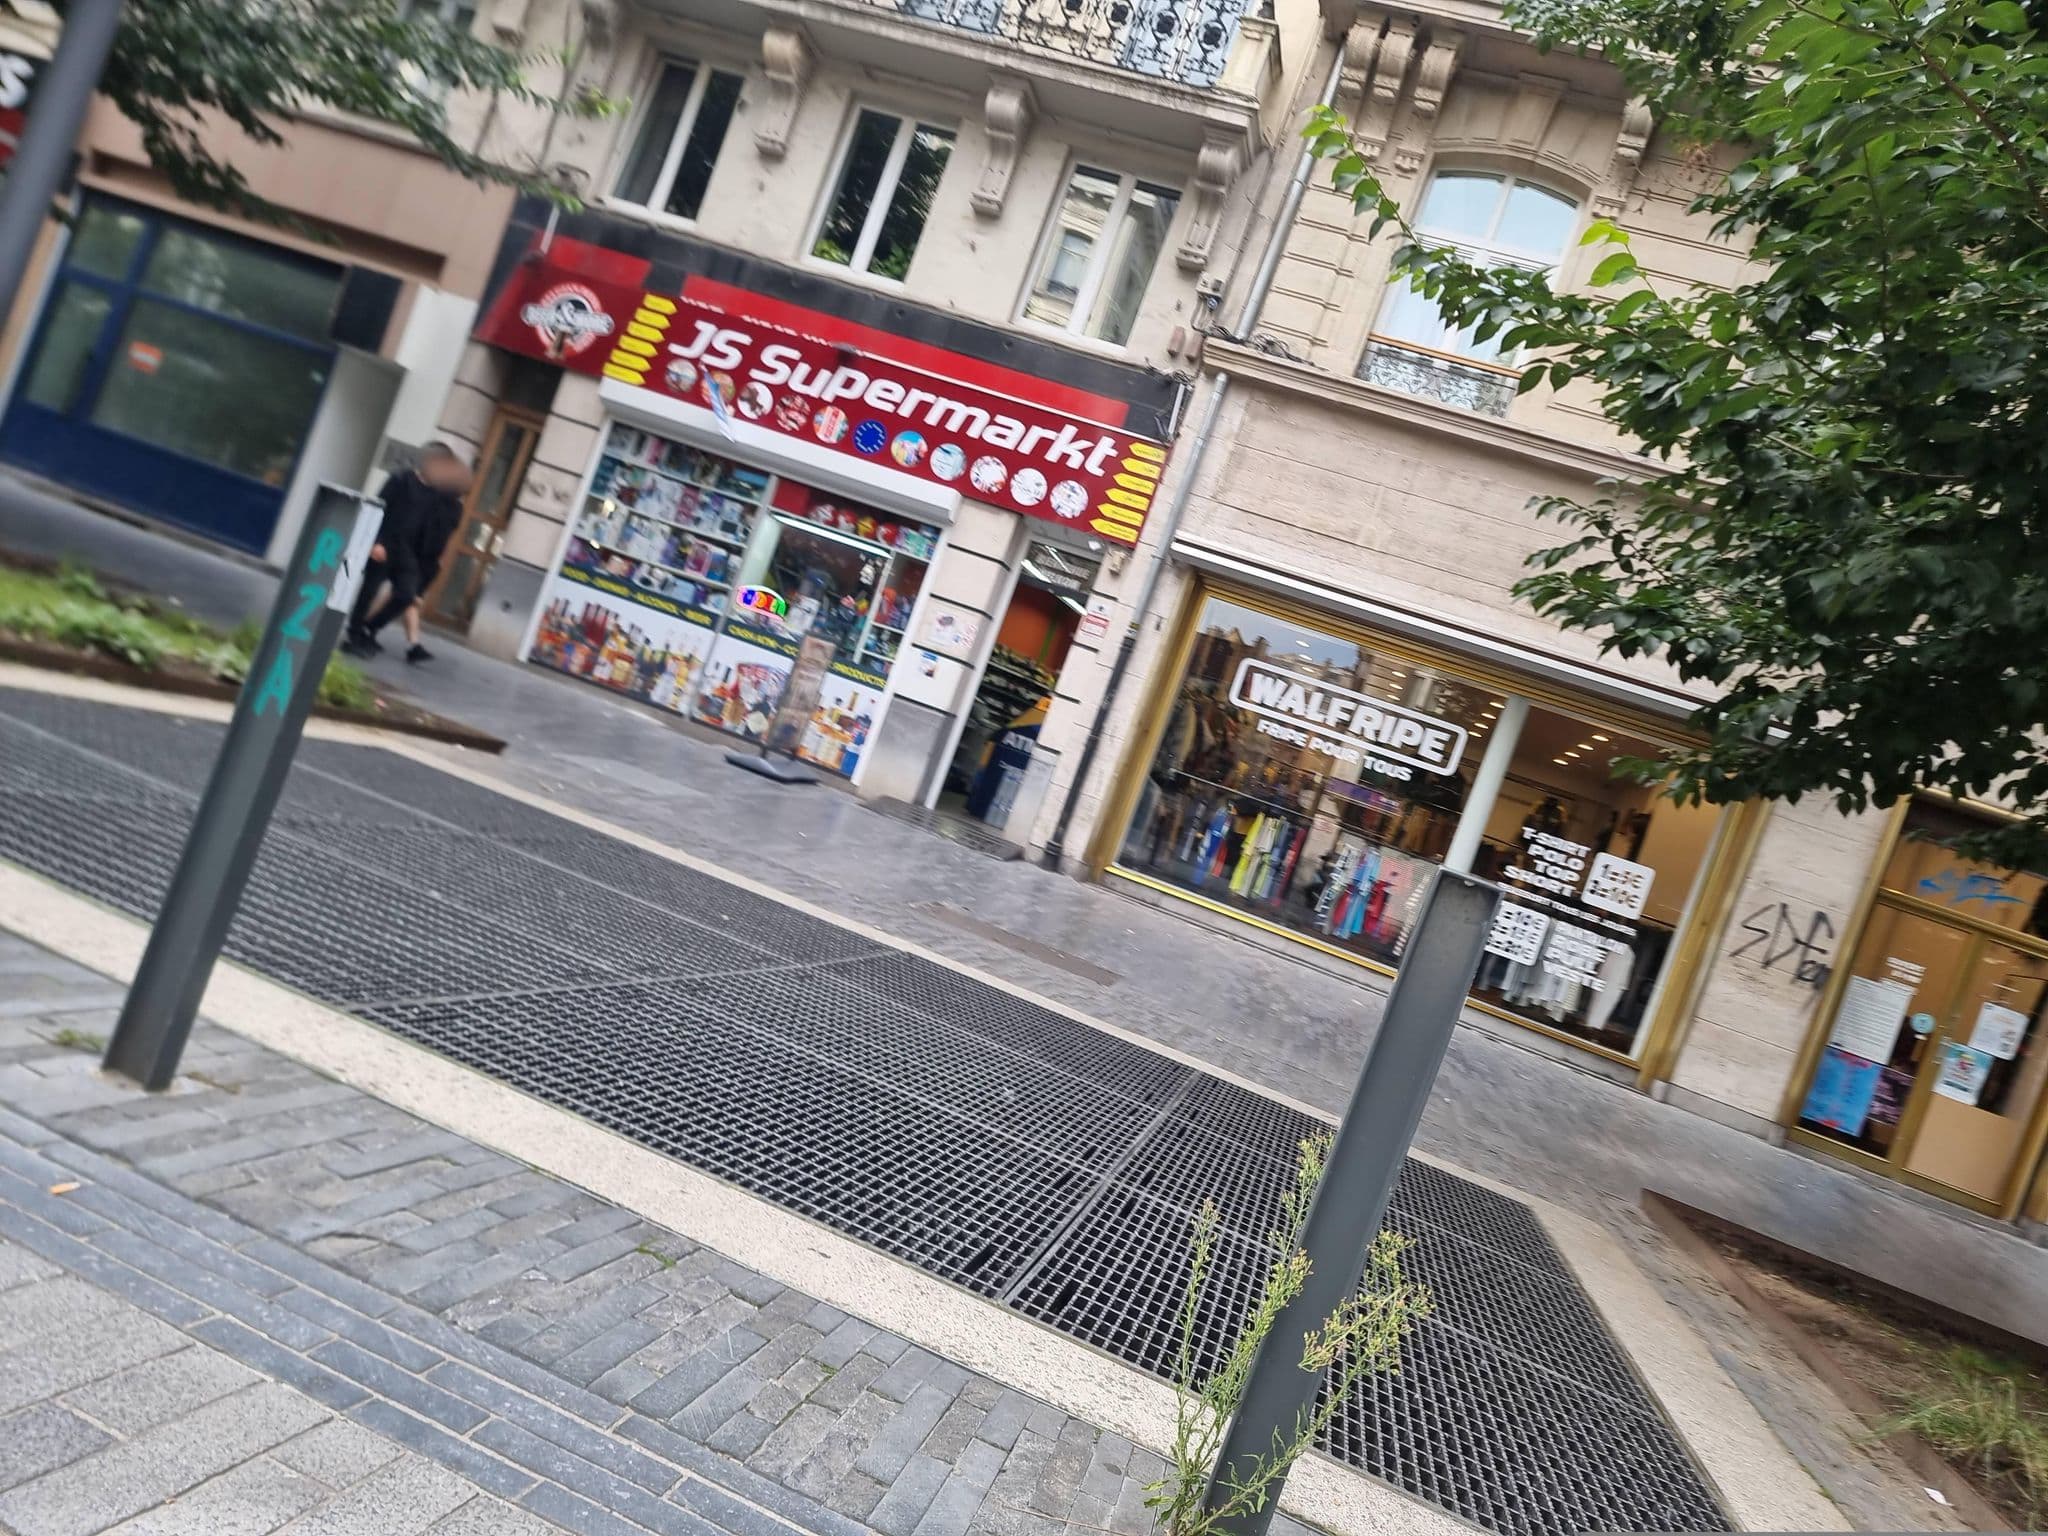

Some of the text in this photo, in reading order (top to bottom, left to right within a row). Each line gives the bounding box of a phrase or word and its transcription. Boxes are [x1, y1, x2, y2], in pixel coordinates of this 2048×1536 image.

[668, 319, 1118, 477] JS Supermarkt
[1249, 672, 1451, 763] WALFRIPE
[1363, 754, 1414, 782] TOUS
[1527, 843, 1585, 871] POLO
[1532, 859, 1581, 883] TOP
[1503, 864, 1577, 898] SHORT
